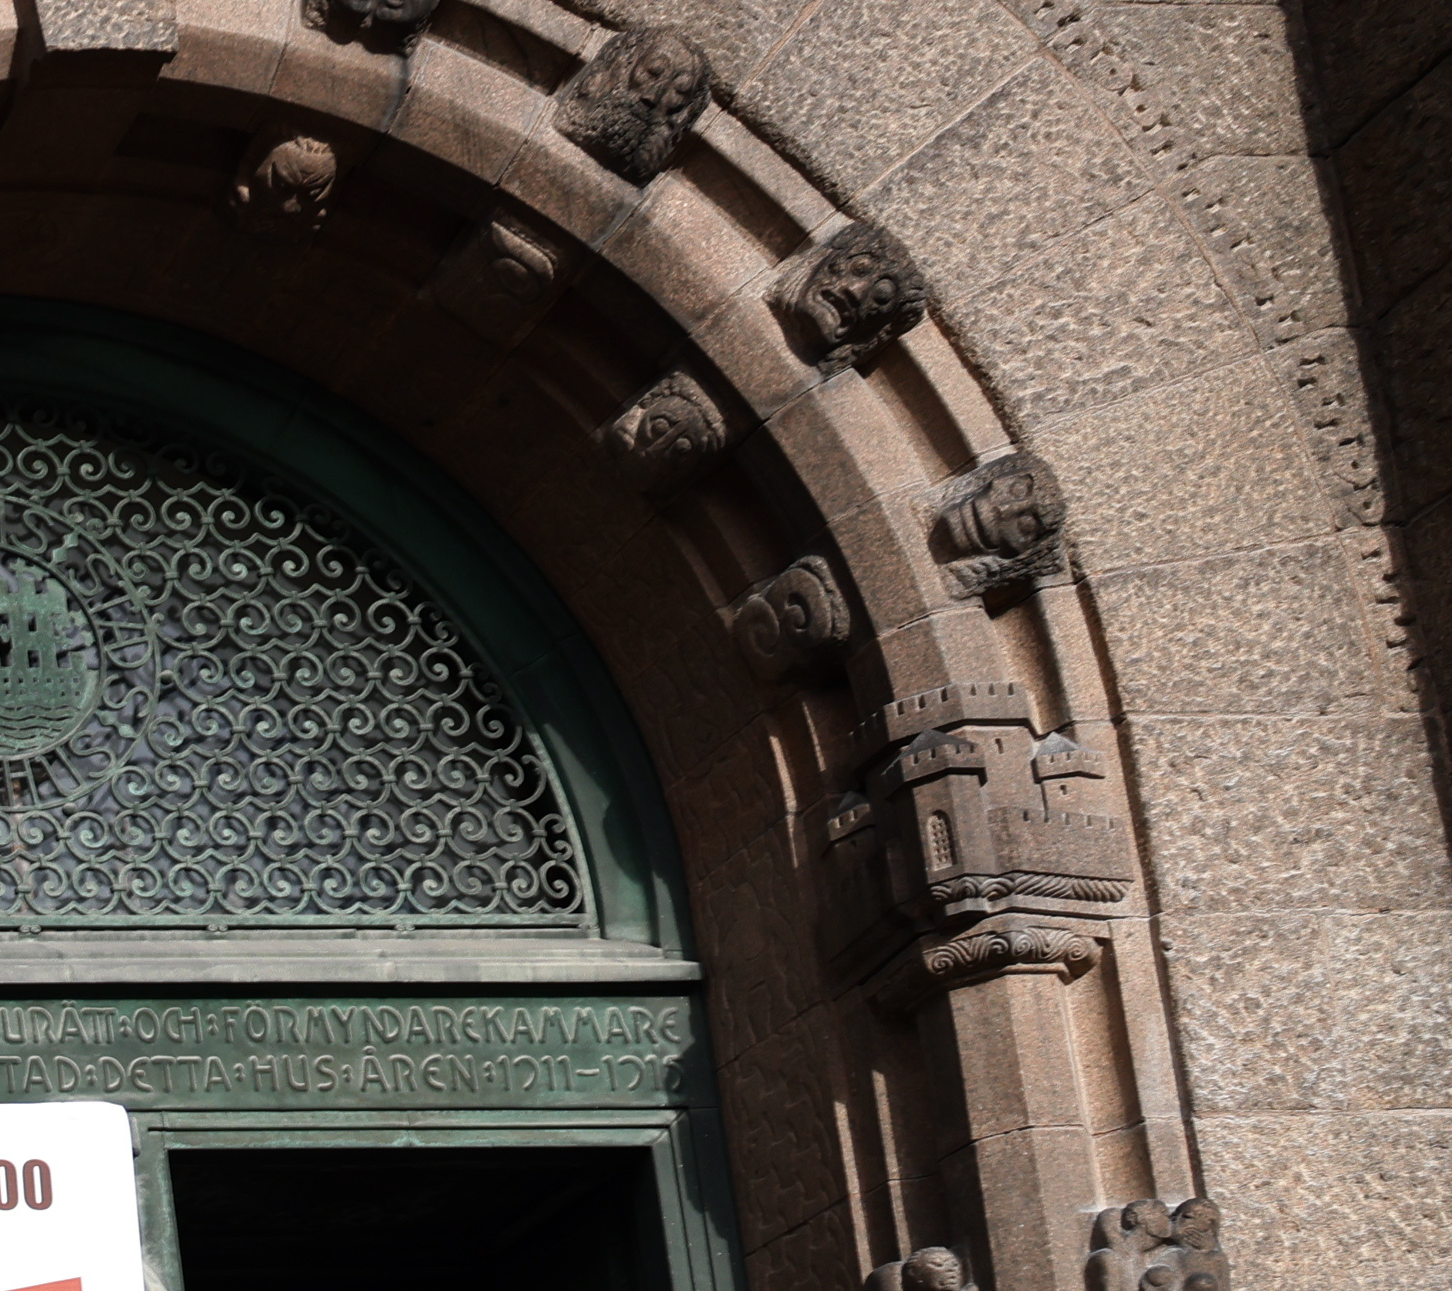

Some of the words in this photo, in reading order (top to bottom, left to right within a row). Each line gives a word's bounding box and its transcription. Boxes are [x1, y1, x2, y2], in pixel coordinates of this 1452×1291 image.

[133, 1005, 204, 1046] OCH
[101, 1055, 233, 1094] DETTA
[249, 1053, 340, 1092] HUS
[360, 1045, 480, 1093] ÅREN
